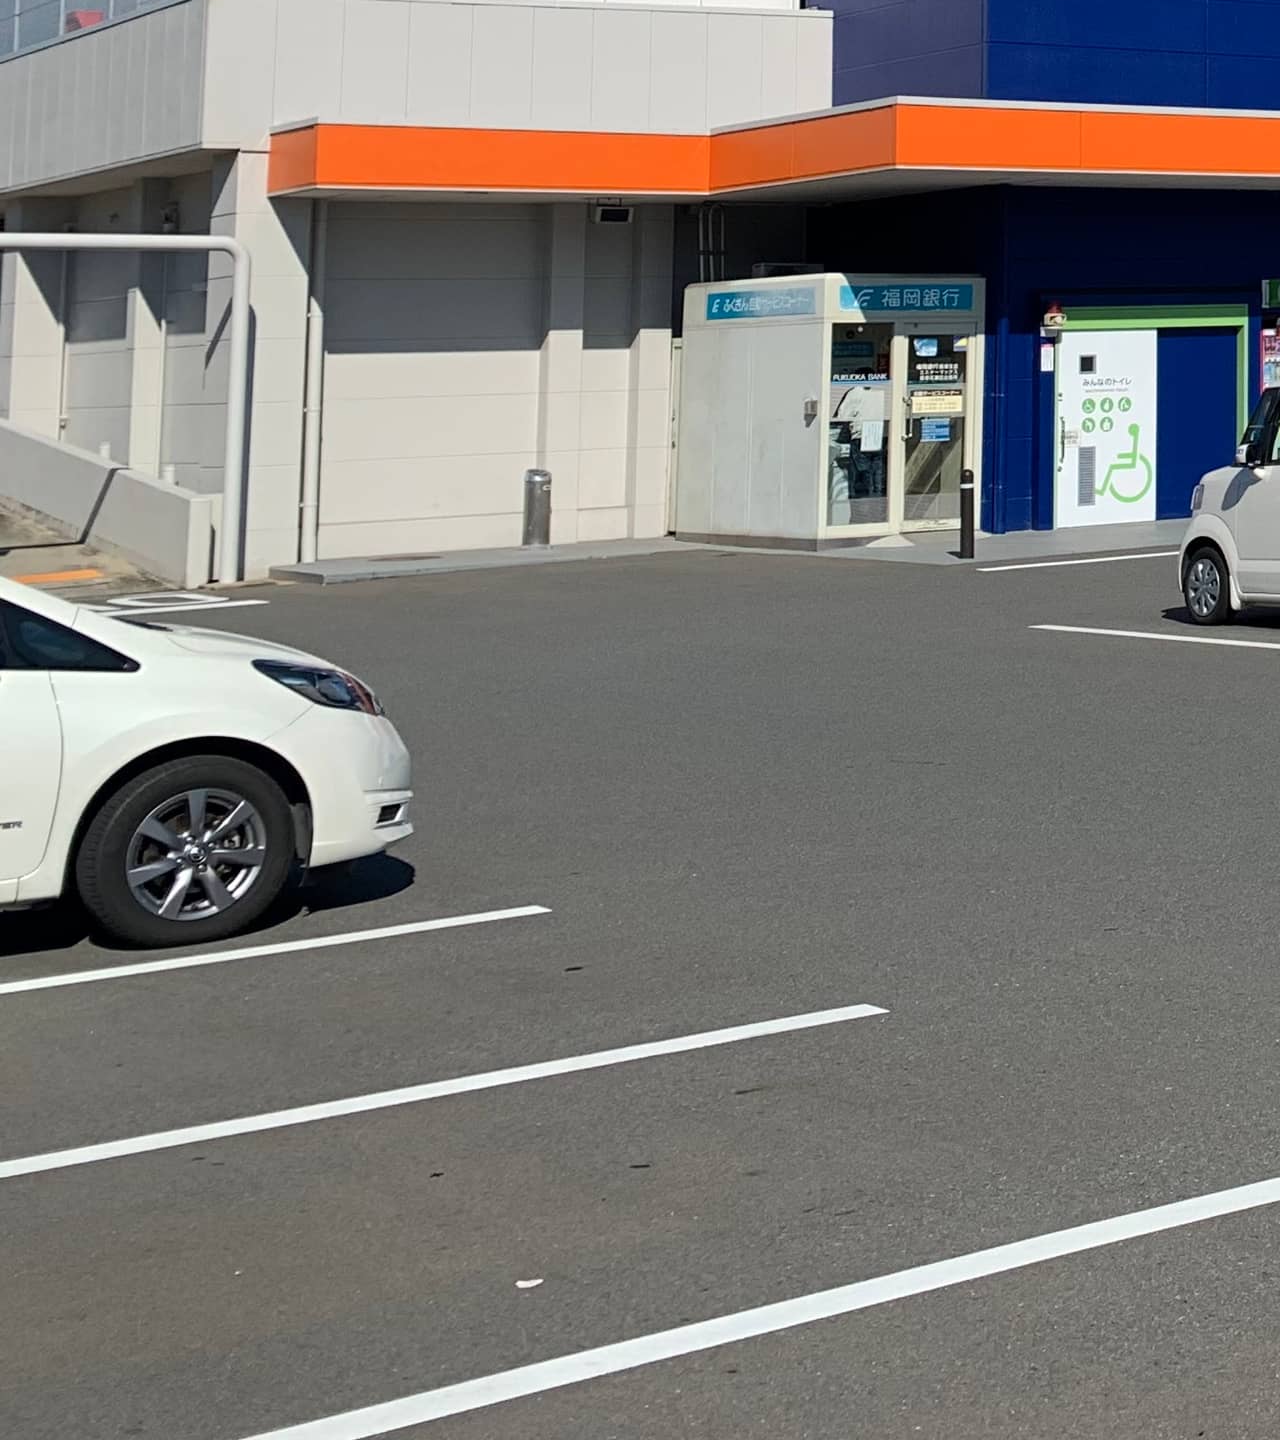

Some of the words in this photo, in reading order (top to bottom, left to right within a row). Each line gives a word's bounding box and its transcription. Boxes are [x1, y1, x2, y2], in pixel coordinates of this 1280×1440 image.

[881, 288, 960, 307] 福岡銀行
[832, 373, 866, 381] FUKUOKA
[1082, 377, 1132, 386] みんなのトイレ
